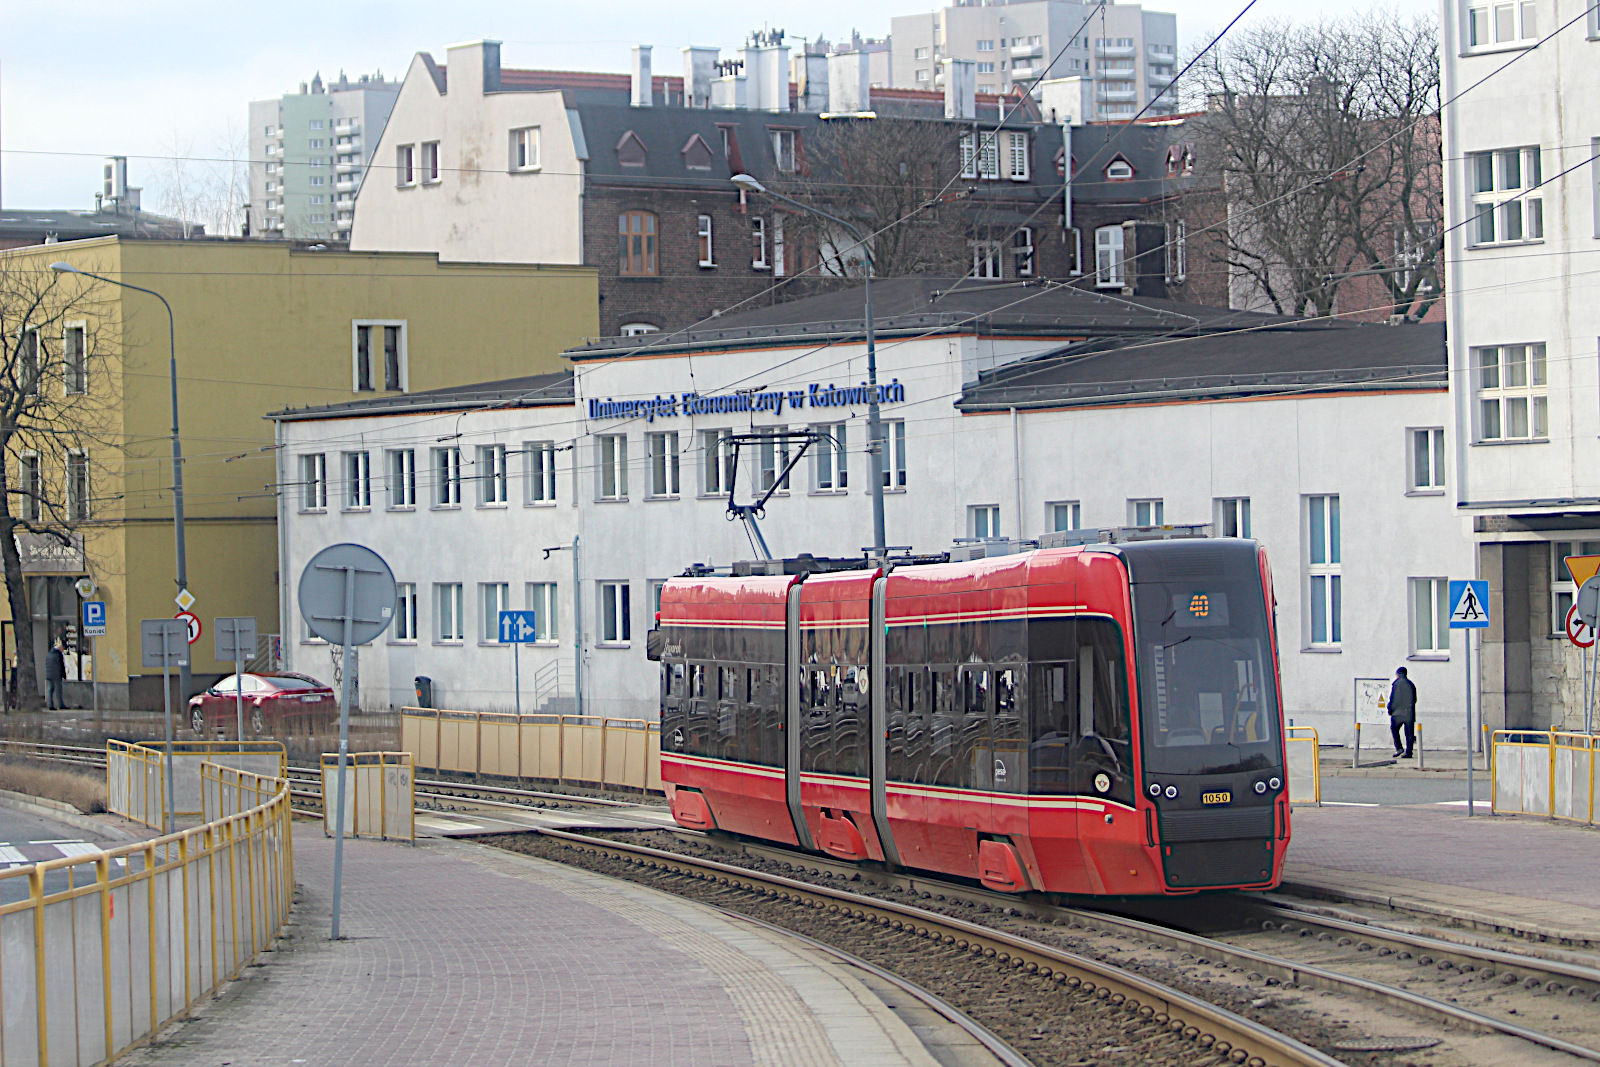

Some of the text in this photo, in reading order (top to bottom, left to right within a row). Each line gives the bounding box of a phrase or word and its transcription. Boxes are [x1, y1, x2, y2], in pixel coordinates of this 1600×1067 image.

[588, 396, 677, 422] Uniwersytet
[682, 392, 783, 416] Ekonomiczny
[788, 390, 804, 408] w
[88, 603, 101, 623] P
[1190, 595, 1208, 616] 40
[1203, 793, 1228, 803] 1050
